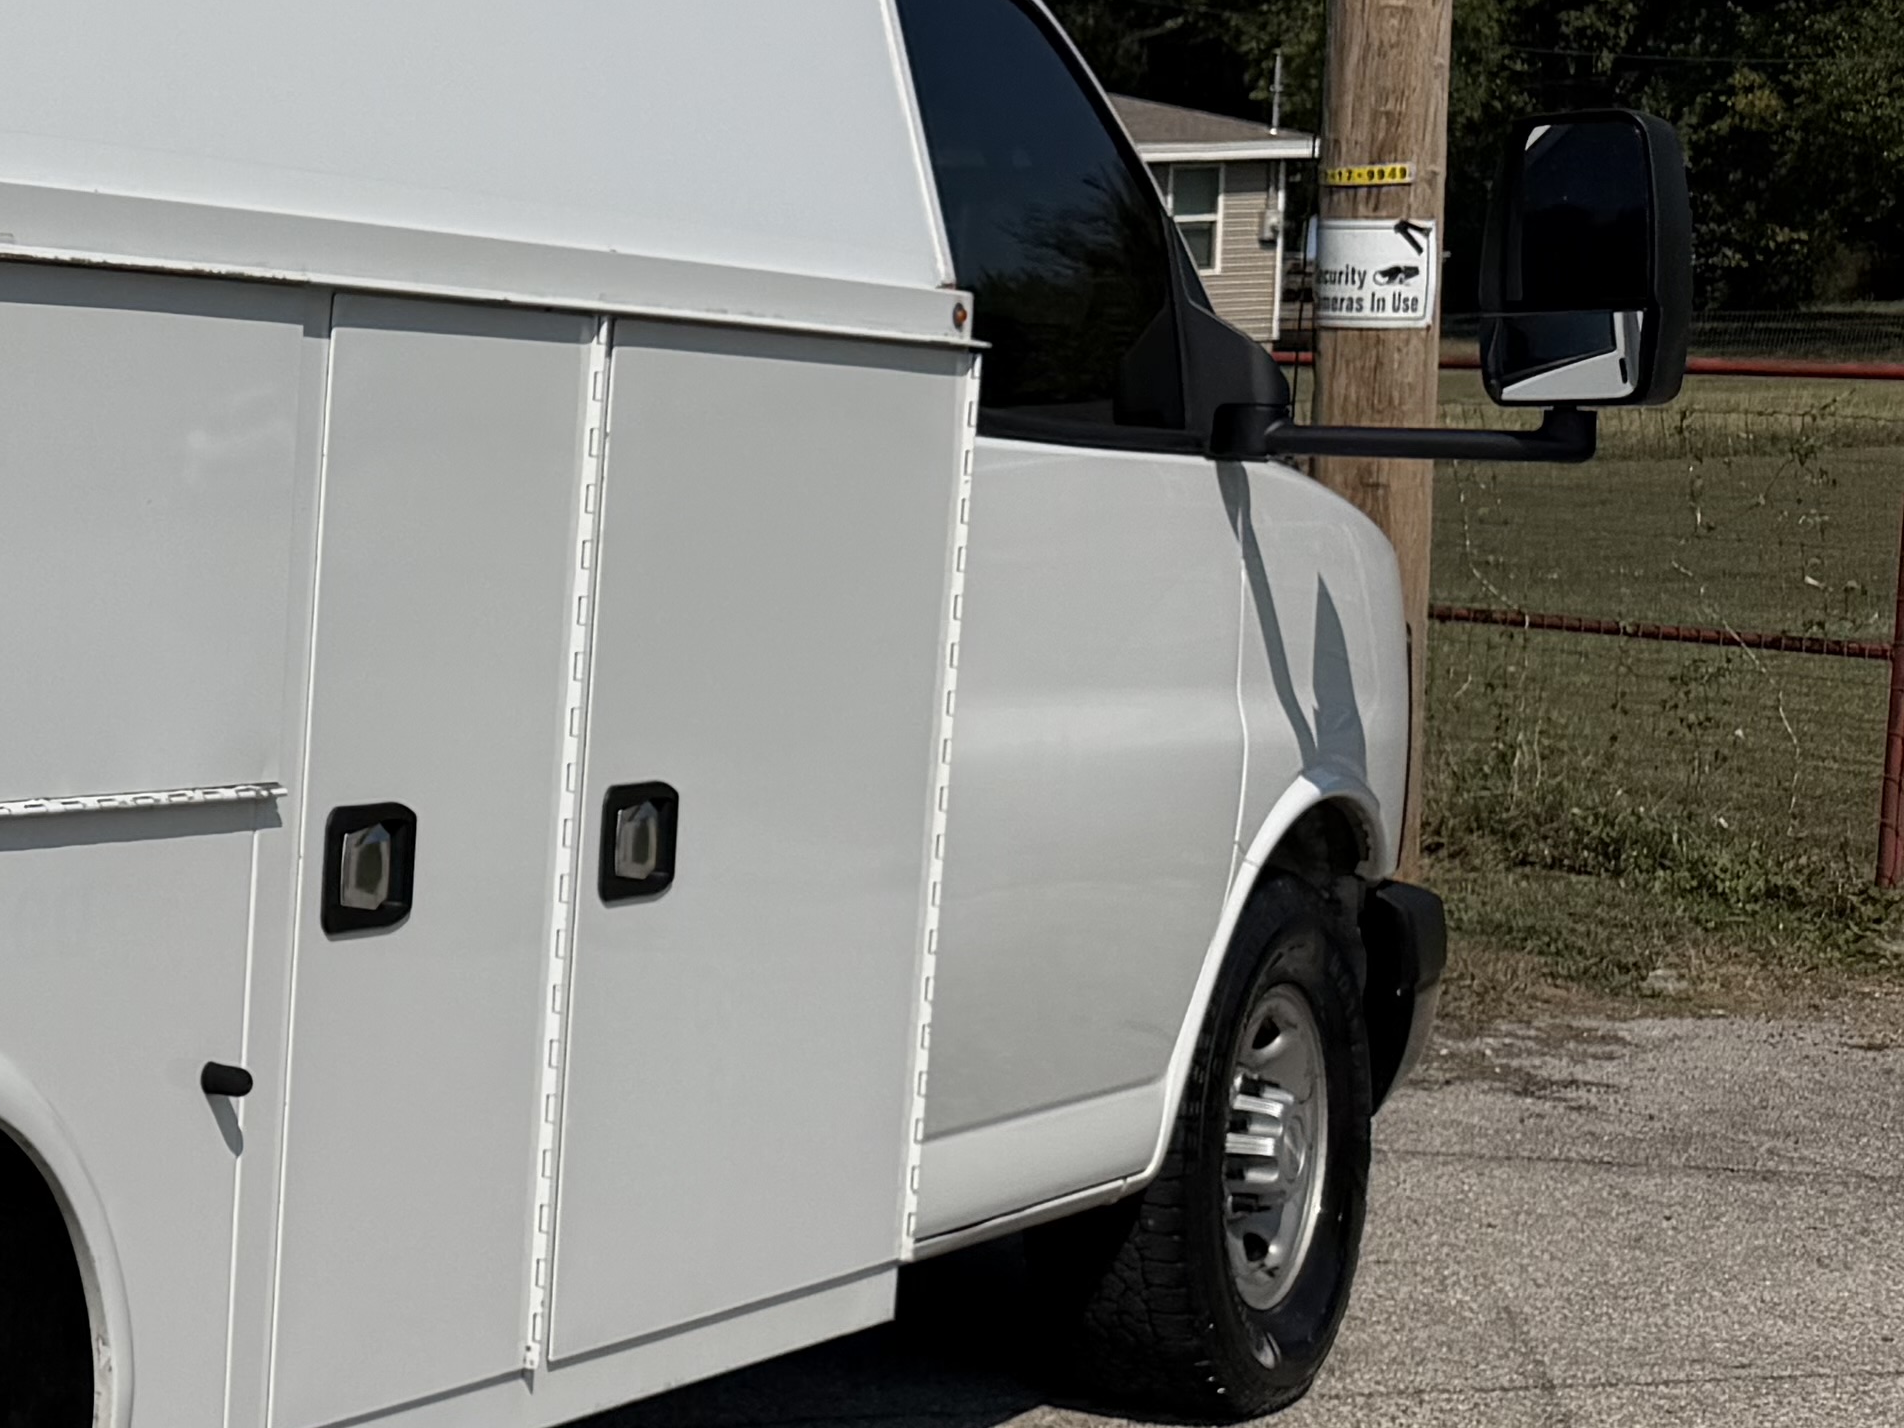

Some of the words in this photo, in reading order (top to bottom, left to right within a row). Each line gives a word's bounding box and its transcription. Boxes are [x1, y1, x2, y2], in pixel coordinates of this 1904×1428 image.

[1317, 263, 1367, 290] ecurity
[1318, 295, 1365, 313] meras
[1369, 291, 1386, 313] In
[1391, 291, 1420, 313] Use
